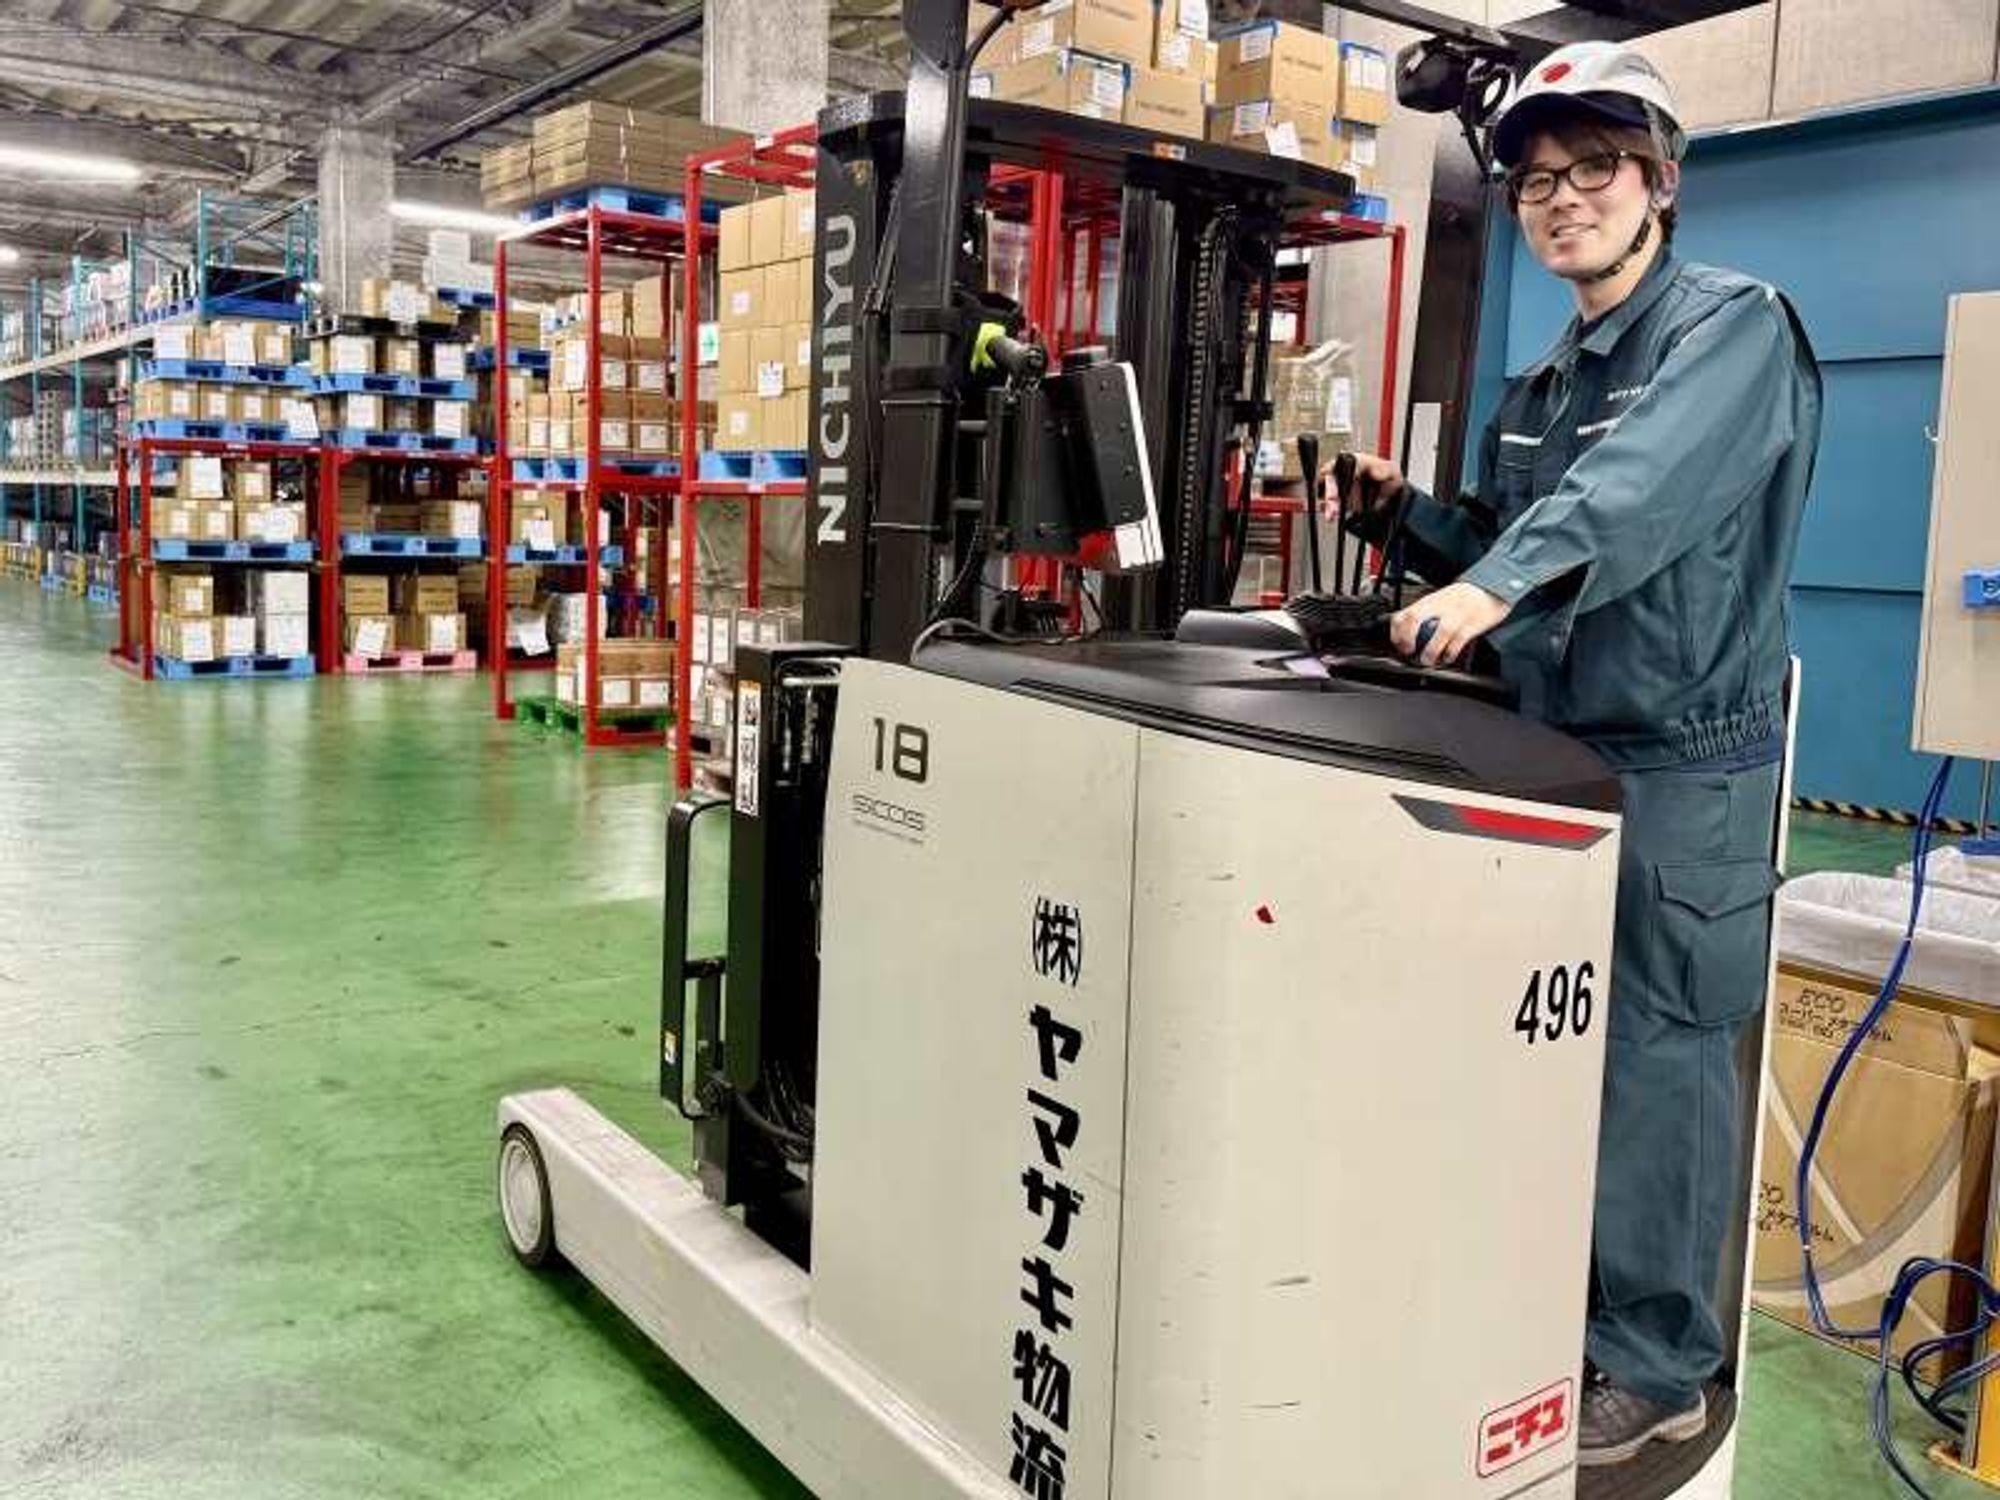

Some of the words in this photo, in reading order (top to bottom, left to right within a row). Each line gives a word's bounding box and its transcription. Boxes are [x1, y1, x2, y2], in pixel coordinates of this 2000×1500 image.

[817, 214, 856, 546] NICHIYU
[873, 717, 929, 784] 18
[1514, 960, 1594, 1044] 496
